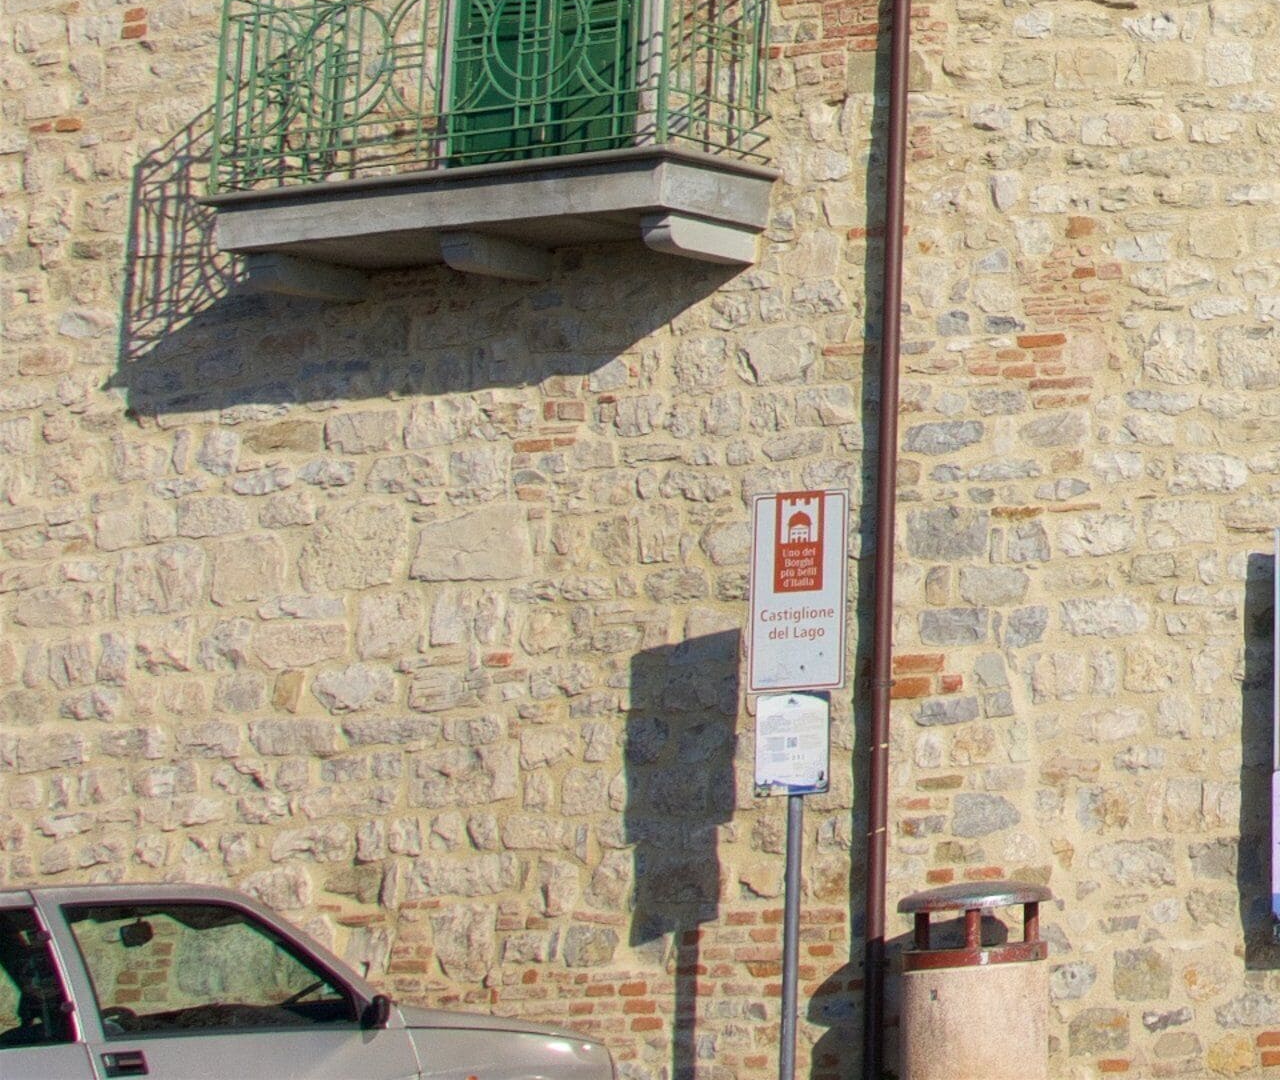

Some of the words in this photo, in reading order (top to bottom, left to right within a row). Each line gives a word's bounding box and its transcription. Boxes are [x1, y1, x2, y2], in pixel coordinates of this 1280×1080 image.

[782, 549, 800, 557] Uno
[785, 558, 814, 568] Borghi
[760, 607, 834, 623] Castiglione
[769, 626, 788, 640] del
[793, 626, 825, 642] Lago
